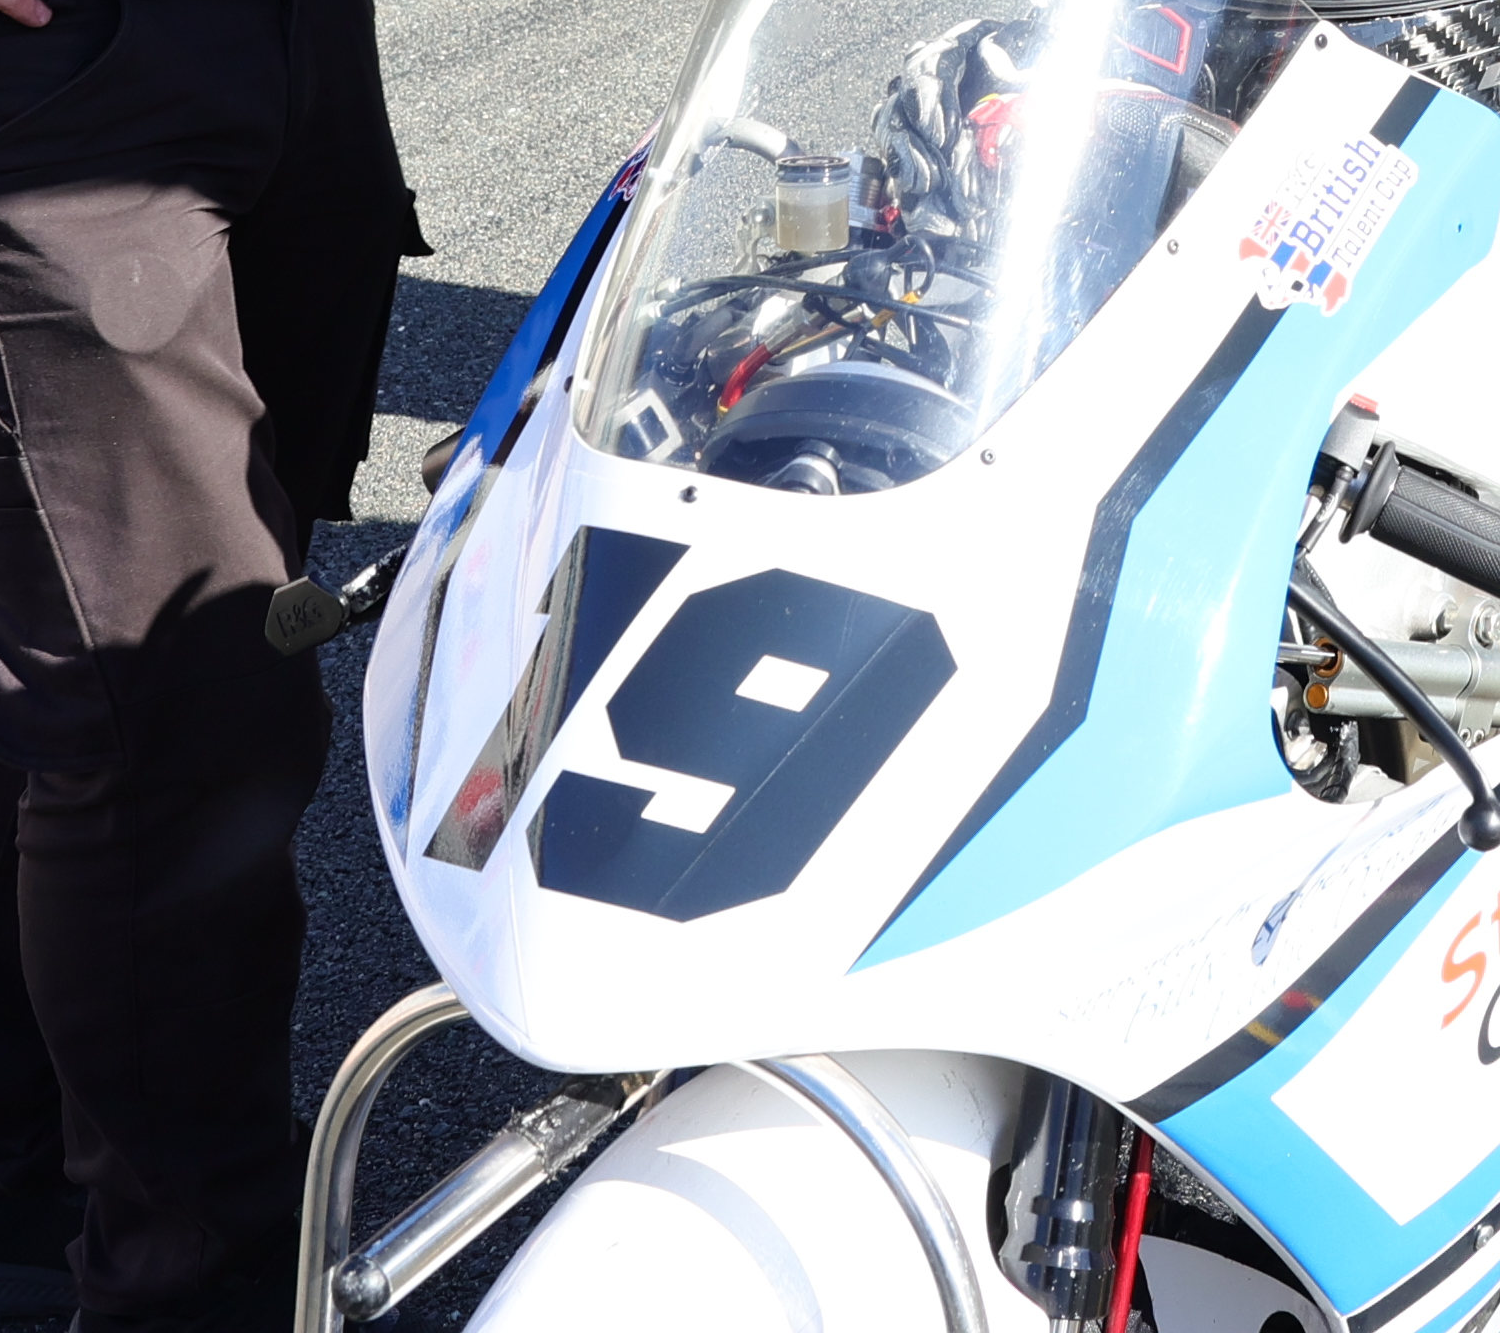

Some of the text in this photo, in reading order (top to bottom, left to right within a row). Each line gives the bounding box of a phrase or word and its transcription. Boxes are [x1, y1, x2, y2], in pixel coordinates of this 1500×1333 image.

[1289, 140, 1381, 257] British
[1331, 159, 1412, 269] Talent Cup
[422, 523, 959, 924] 19
